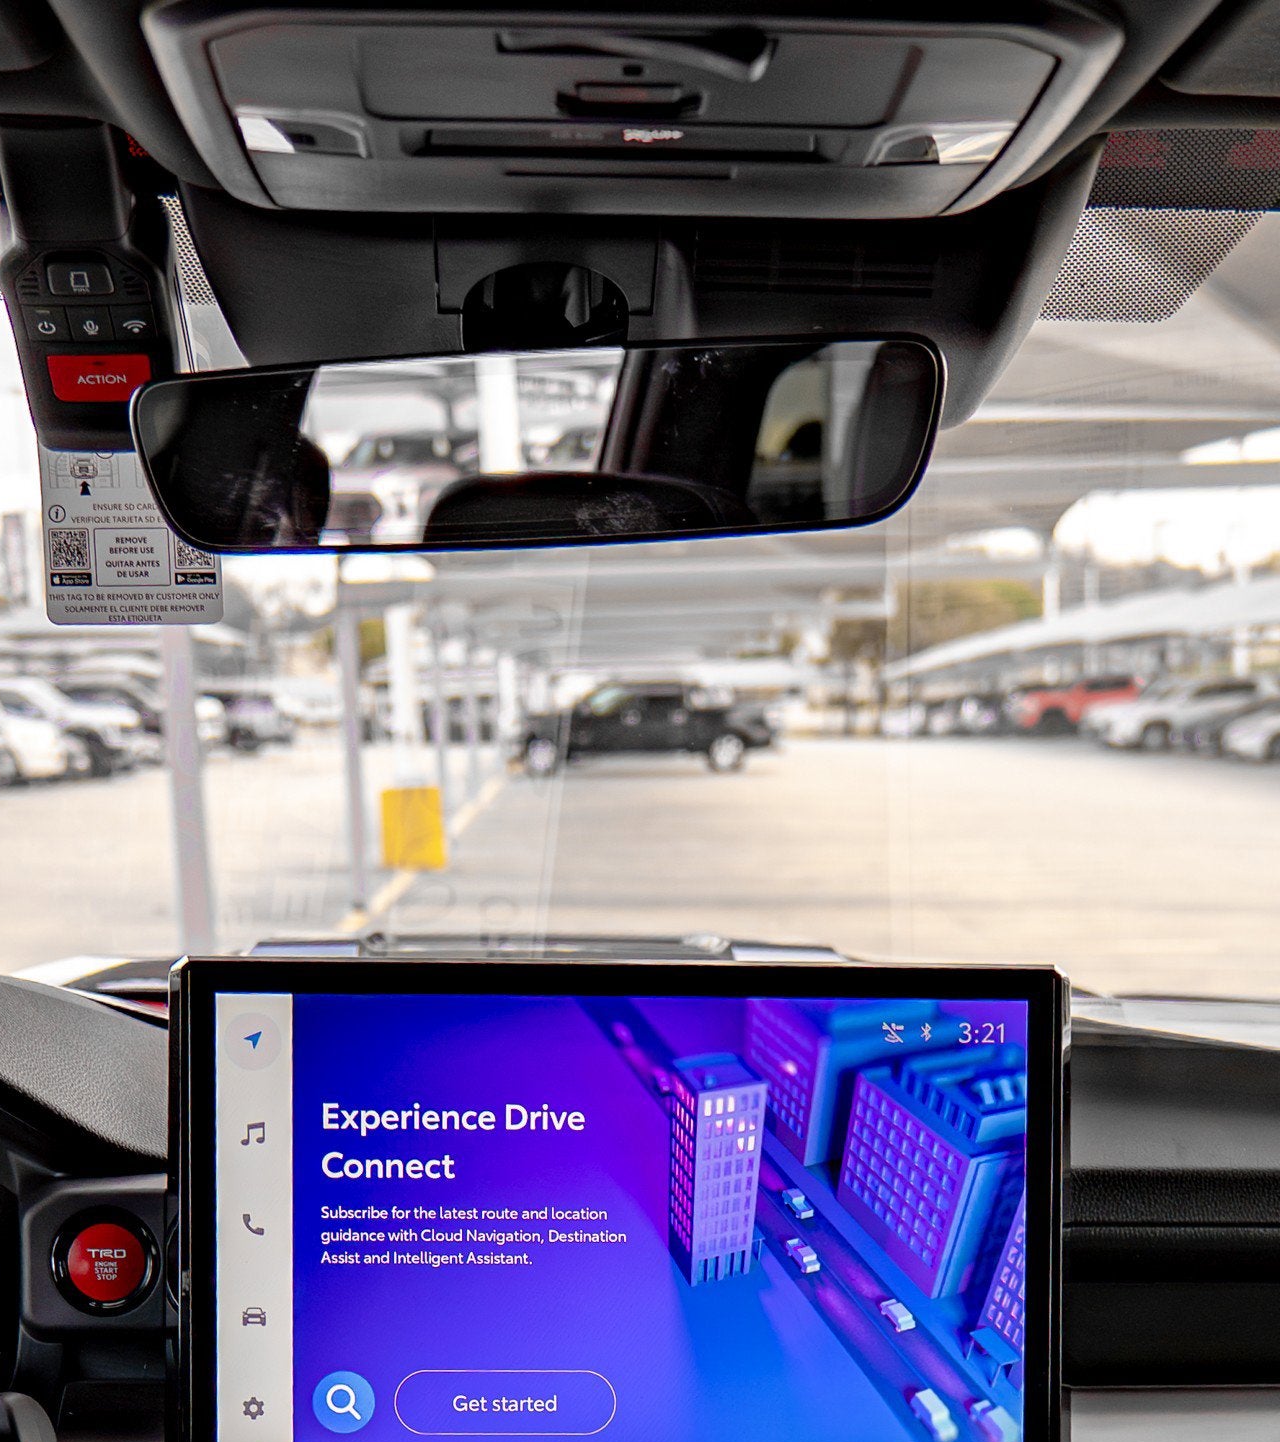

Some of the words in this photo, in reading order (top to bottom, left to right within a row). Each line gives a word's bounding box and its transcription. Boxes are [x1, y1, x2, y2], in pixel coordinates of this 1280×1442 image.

[77, 374, 127, 385] ACTION
[93, 503, 122, 511] ENSURE
[124, 503, 135, 511] SD
[71, 516, 111, 524] VERIFIQUE
[113, 516, 143, 524] TARJETA
[105, 560, 135, 568] QUITAR
[135, 560, 160, 568] ANTES
[107, 593, 144, 601] REMOVED
[957, 1022, 1006, 1047] 3:21
[322, 1102, 496, 1137] Experience
[505, 1103, 586, 1131] Drive
[321, 1151, 455, 1179] Connect
[321, 1205, 388, 1220] Subscribe
[391, 1206, 411, 1220] for
[413, 1206, 437, 1220] the
[439, 1206, 478, 1220] latest
[482, 1208, 518, 1221] route
[521, 1207, 548, 1221] and
[551, 1207, 608, 1221] location
[321, 1228, 386, 1245] guidance
[388, 1229, 418, 1242] with
[421, 1229, 463, 1243] Cloud
[466, 1229, 545, 1245] Navigation,
[548, 1229, 627, 1244] Destination
[86, 1248, 127, 1259] TRD
[321, 1250, 361, 1265] Assist
[363, 1251, 390, 1265] and
[393, 1251, 464, 1268] Intelligent
[466, 1252, 533, 1266] Assistant.
[451, 1393, 487, 1414] Get
[491, 1393, 558, 1414] started
